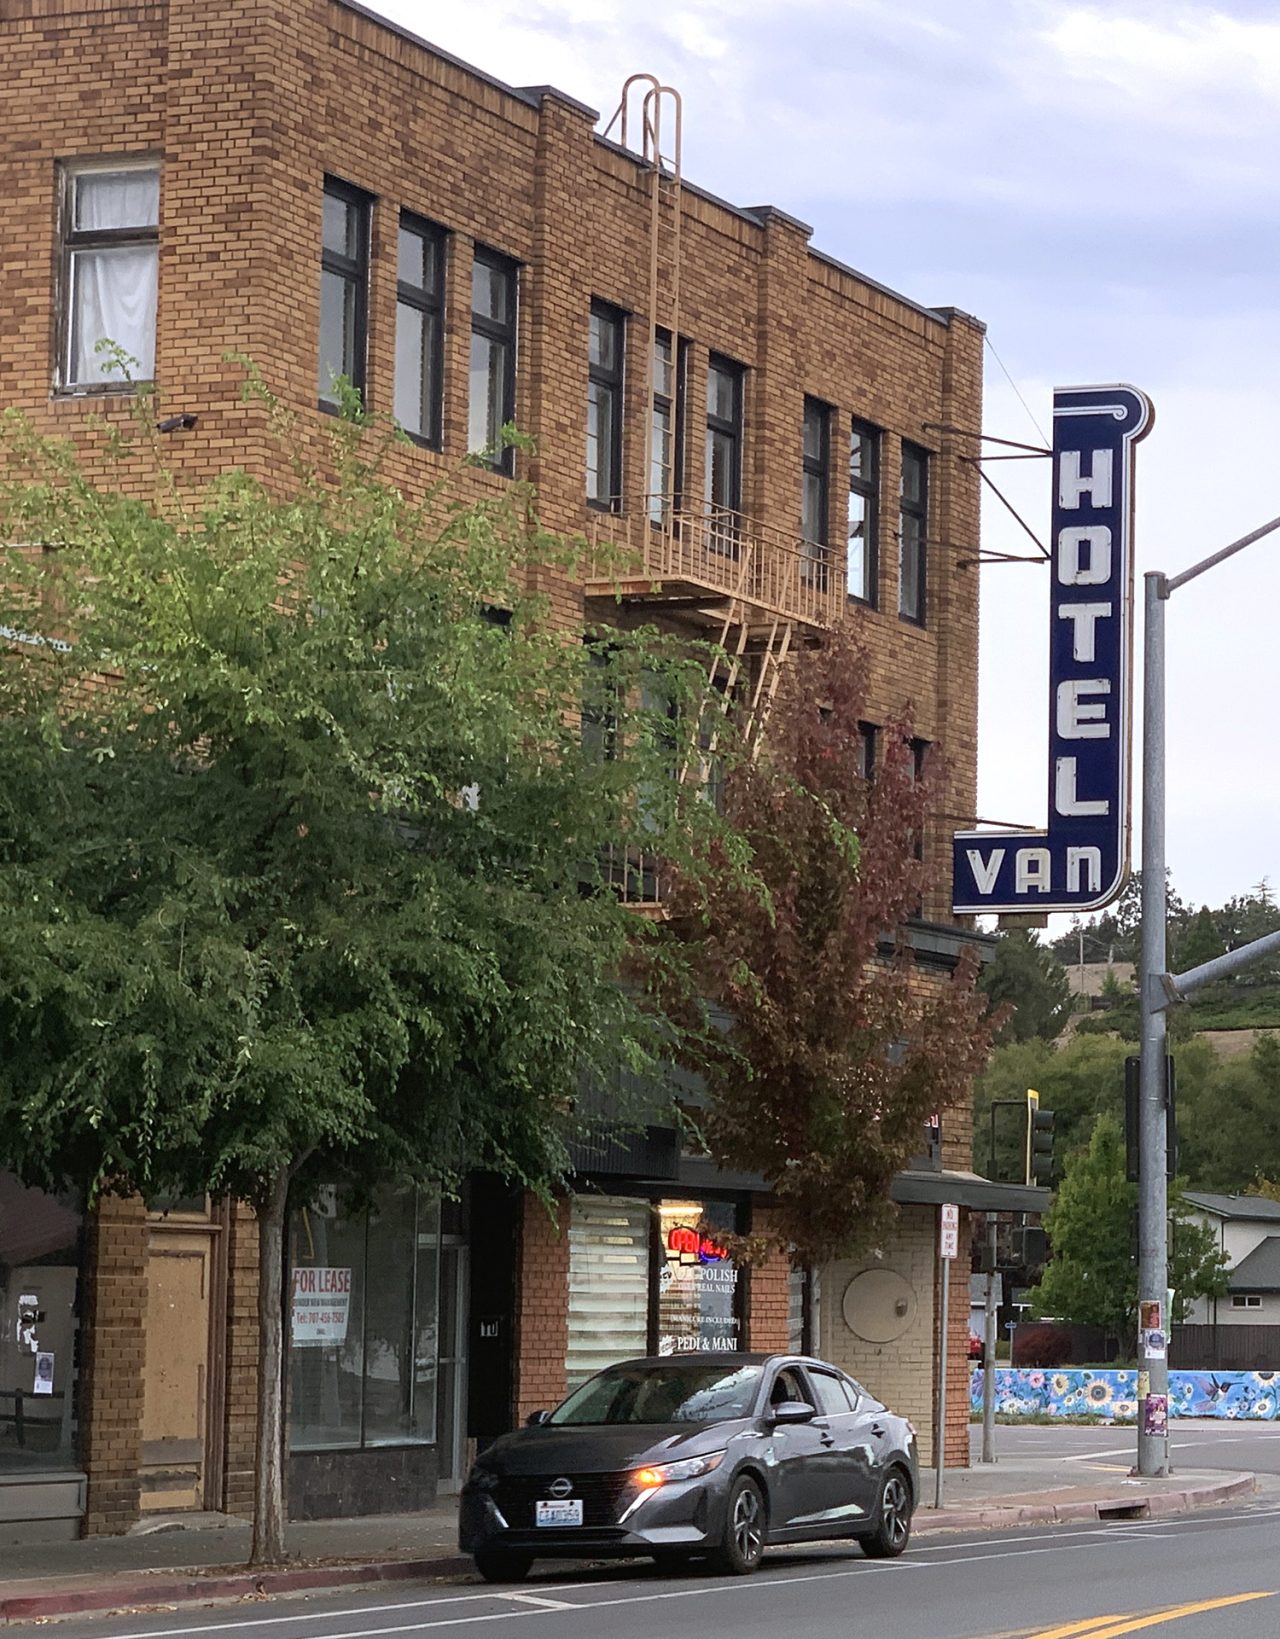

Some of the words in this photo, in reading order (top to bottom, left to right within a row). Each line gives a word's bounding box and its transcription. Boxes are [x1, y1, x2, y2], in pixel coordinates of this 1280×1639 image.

[1056, 448, 1113, 817] HOTEL
[670, 1230, 700, 1252] OPEN
[294, 1270, 315, 1292] FOR
[319, 1270, 350, 1293] LEASE
[700, 1267, 738, 1282] POLISH
[715, 1285, 735, 1294] NAILS
[678, 1337, 700, 1350] PEDI
[702, 1338, 709, 1351] &
[712, 1337, 738, 1351] MANI
